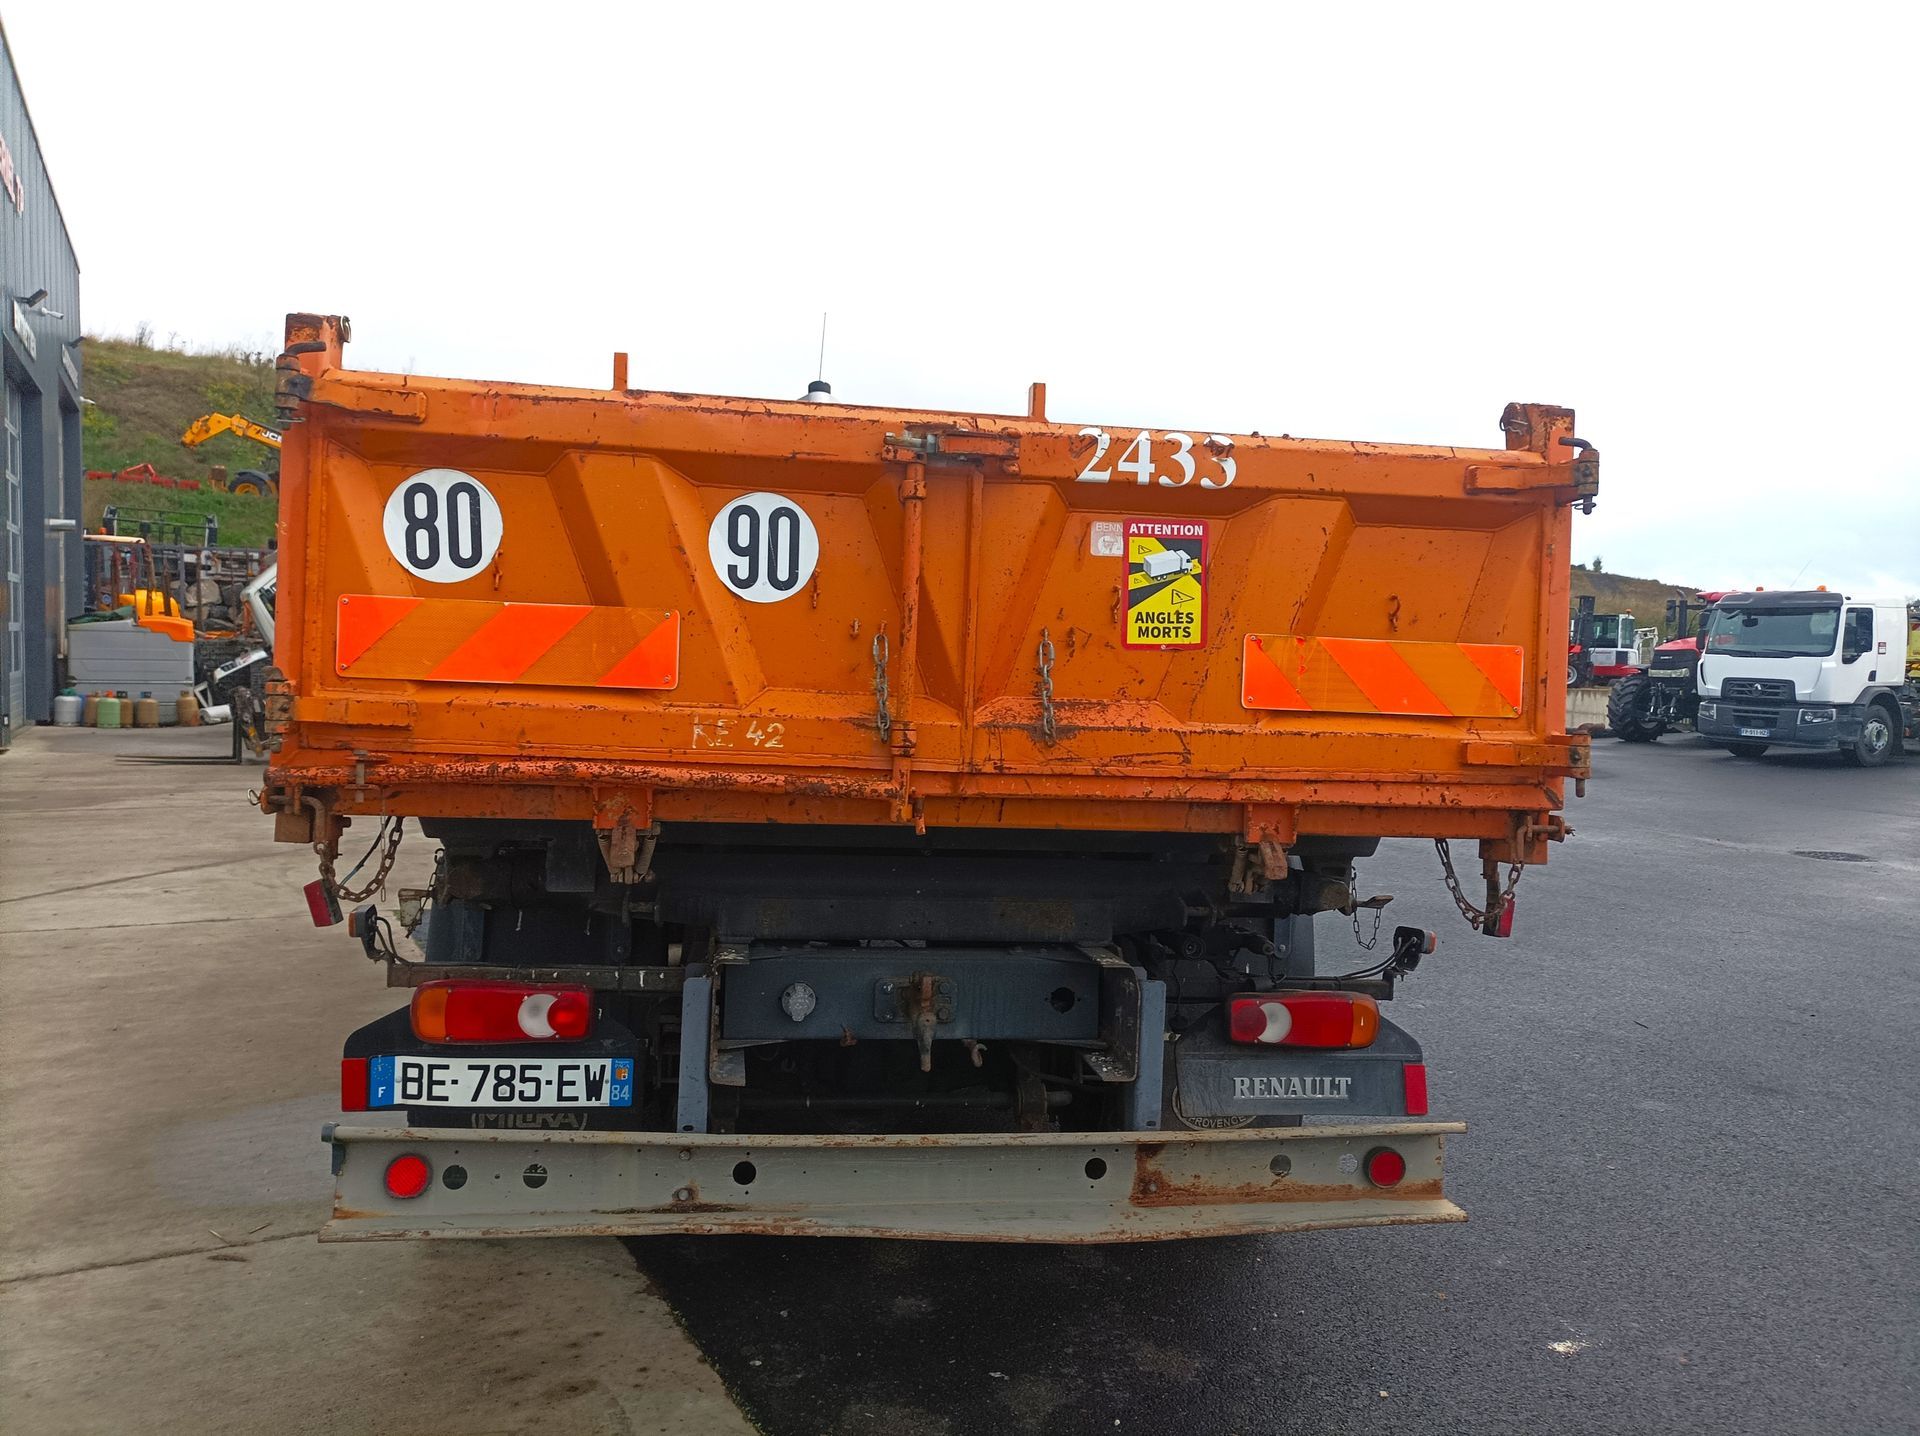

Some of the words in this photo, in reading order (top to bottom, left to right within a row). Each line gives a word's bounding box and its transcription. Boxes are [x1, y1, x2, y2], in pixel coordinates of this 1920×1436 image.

[1075, 427, 1237, 490] 2433
[403, 481, 482, 570] 80
[1129, 523, 1203, 536] ATTENTION
[727, 504, 800, 591] 90
[1135, 611, 1194, 624] ANGLES
[1138, 626, 1191, 638] MORTS
[746, 720, 785, 748] 42
[378, 1086, 386, 1097] F
[401, 1062, 607, 1102] BE-785-EW
[611, 1085, 629, 1100] 84
[1233, 1077, 1352, 1099] RENAULT
